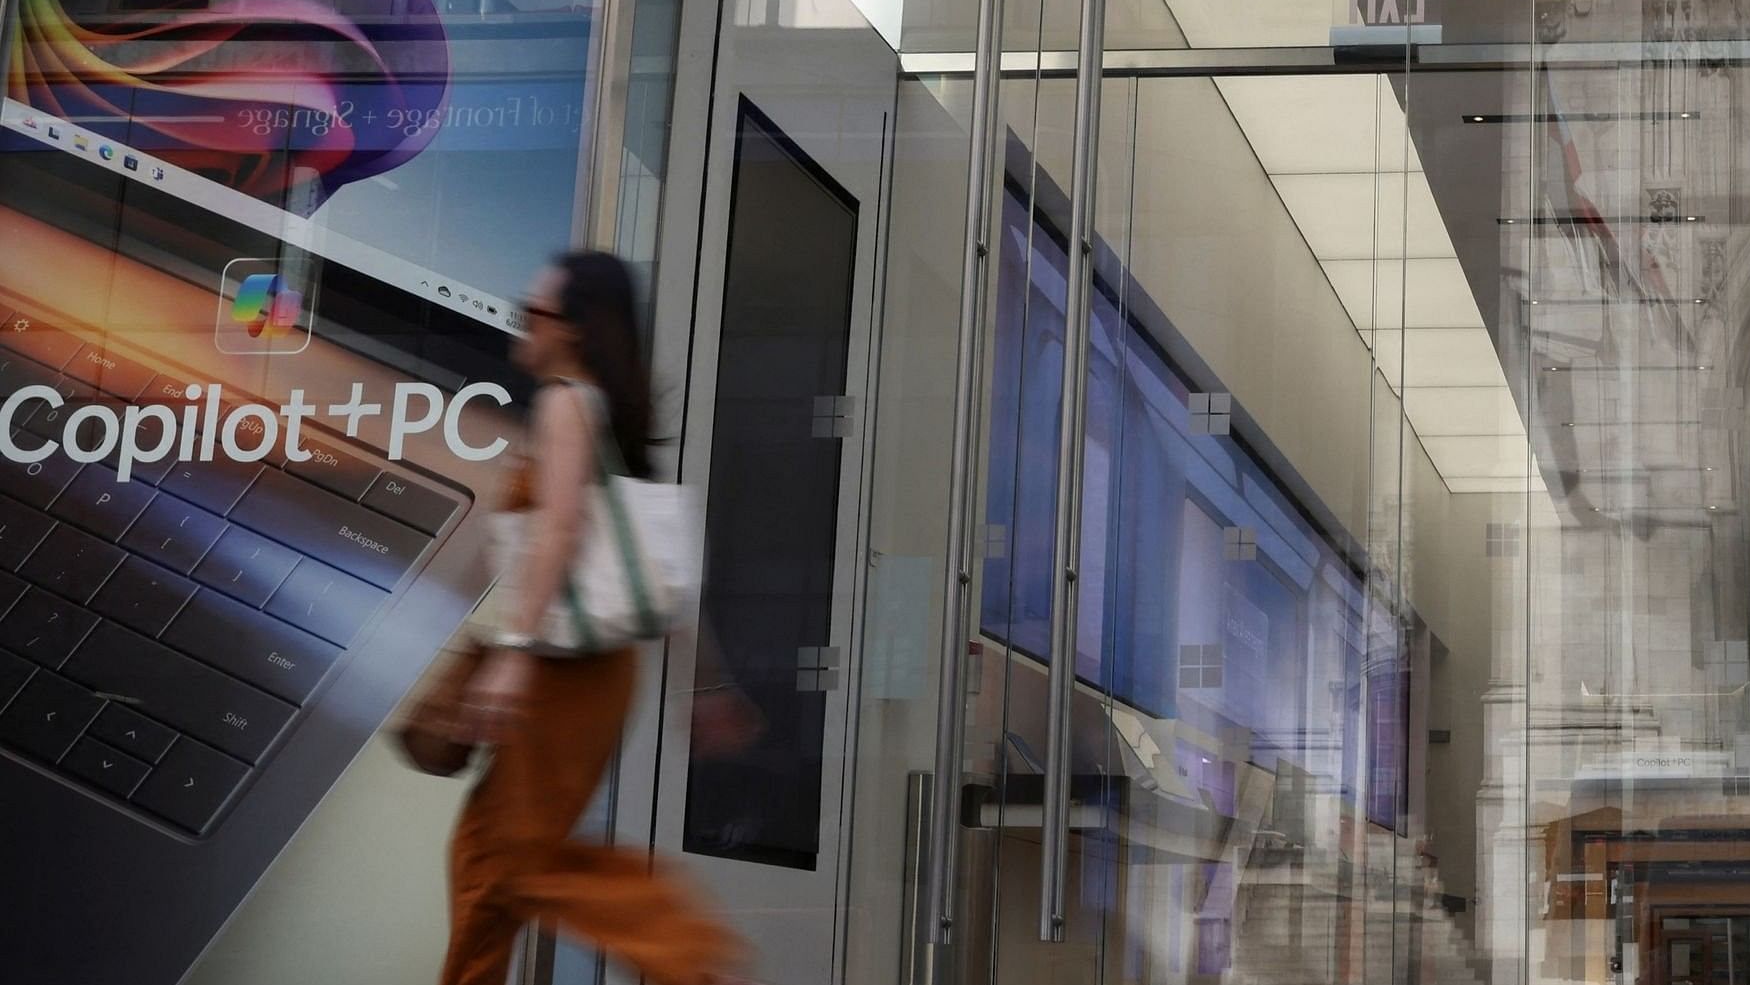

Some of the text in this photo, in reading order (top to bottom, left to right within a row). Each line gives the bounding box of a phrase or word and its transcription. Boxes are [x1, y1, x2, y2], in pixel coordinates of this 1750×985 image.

[87, 351, 117, 370] Home
[386, 480, 406, 496] Del
[337, 525, 389, 555] Backspace
[267, 651, 296, 672] Enter
[222, 712, 248, 731] Shift
